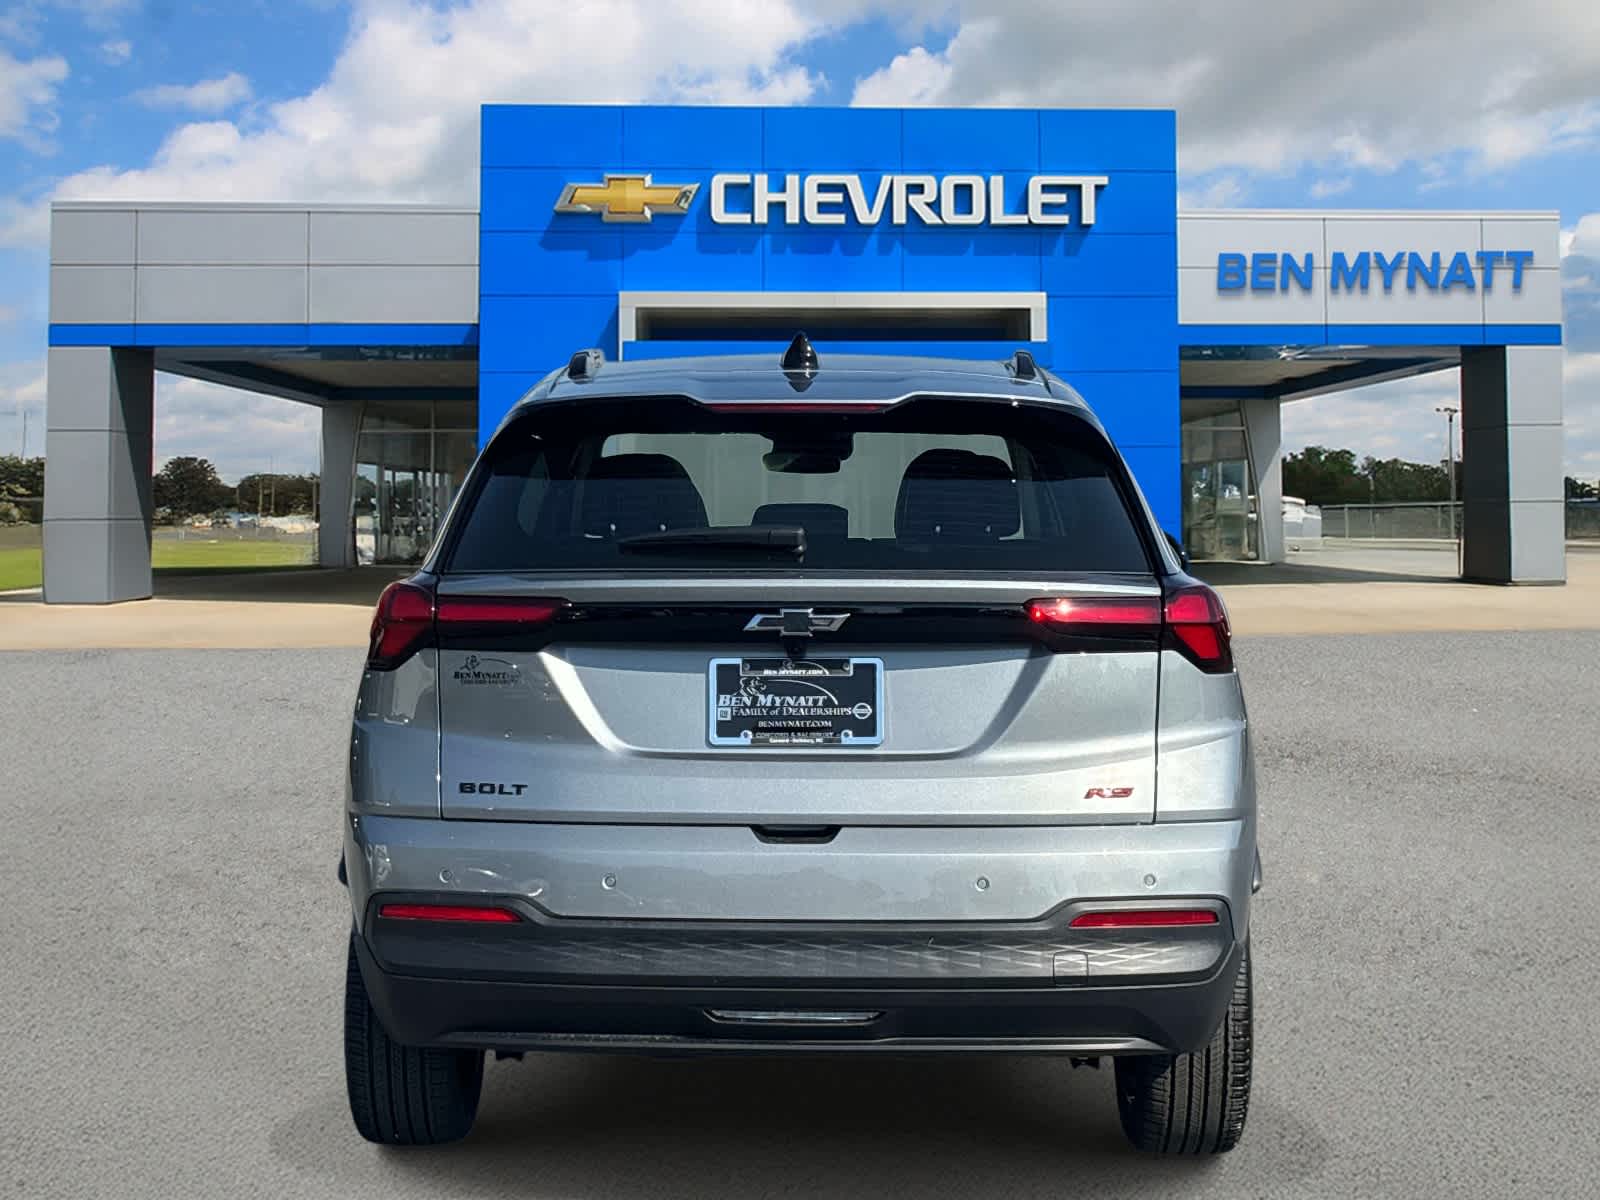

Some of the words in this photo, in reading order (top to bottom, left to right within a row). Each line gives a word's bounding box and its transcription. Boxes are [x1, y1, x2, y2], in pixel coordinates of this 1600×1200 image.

[710, 173, 1109, 225] CHEVROLET
[1217, 252, 1314, 291] BEN
[1330, 250, 1534, 291] MYNATT
[718, 695, 752, 707] BEN
[758, 695, 828, 707] MYNATT
[732, 707, 769, 716] FAMILY
[783, 707, 852, 716] DEALERSHIPS
[758, 720, 832, 728] BENMYNATT.COM
[459, 782, 528, 796] BOLT
[1084, 787, 1134, 799] RS
